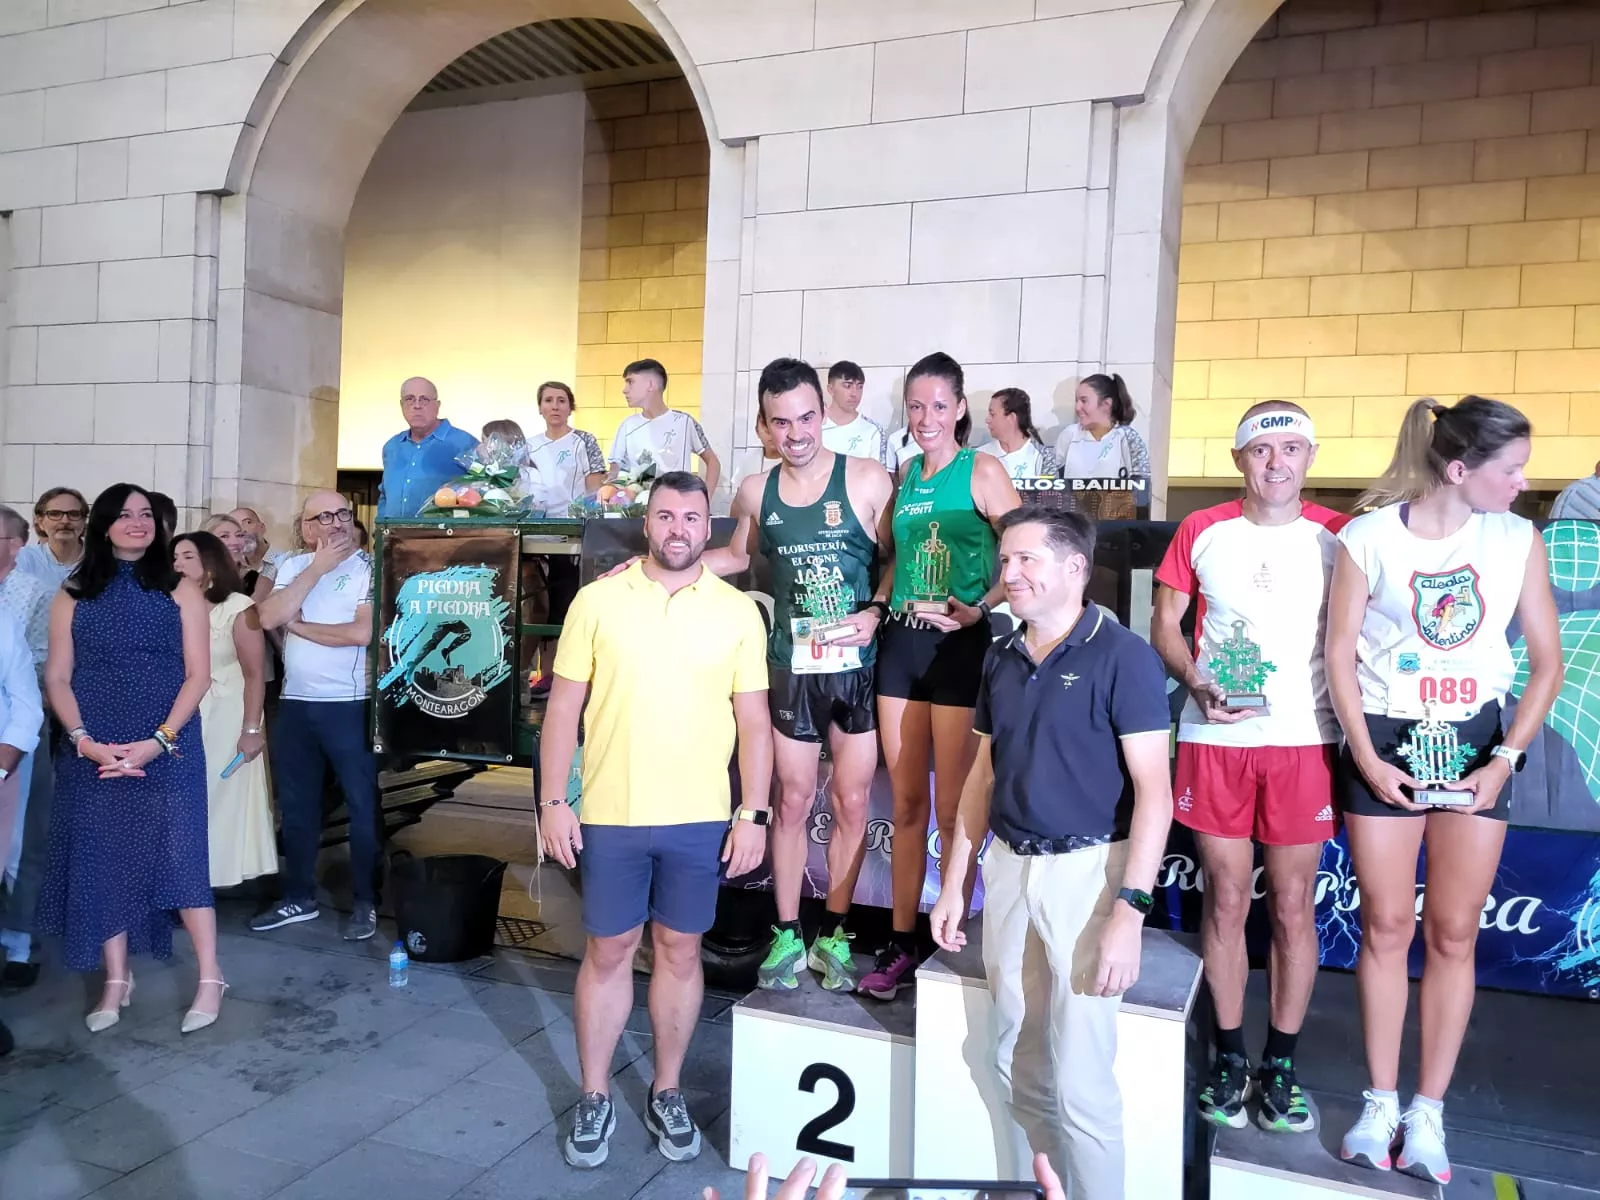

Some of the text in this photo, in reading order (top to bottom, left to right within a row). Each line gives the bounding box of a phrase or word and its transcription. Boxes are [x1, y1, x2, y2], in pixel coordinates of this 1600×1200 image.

[1260, 415, 1293, 429] GMP
[1014, 479, 1146, 491] RLOS BAILIN
[777, 540, 848, 555] FLORISTERÍA
[791, 557, 806, 566] EL
[417, 580, 481, 598] PIEDRA
[409, 600, 490, 619] A PIEDRA
[1419, 676, 1478, 704] 089
[406, 686, 486, 715] MONTEARAGÓN
[796, 1062, 856, 1163] 2
